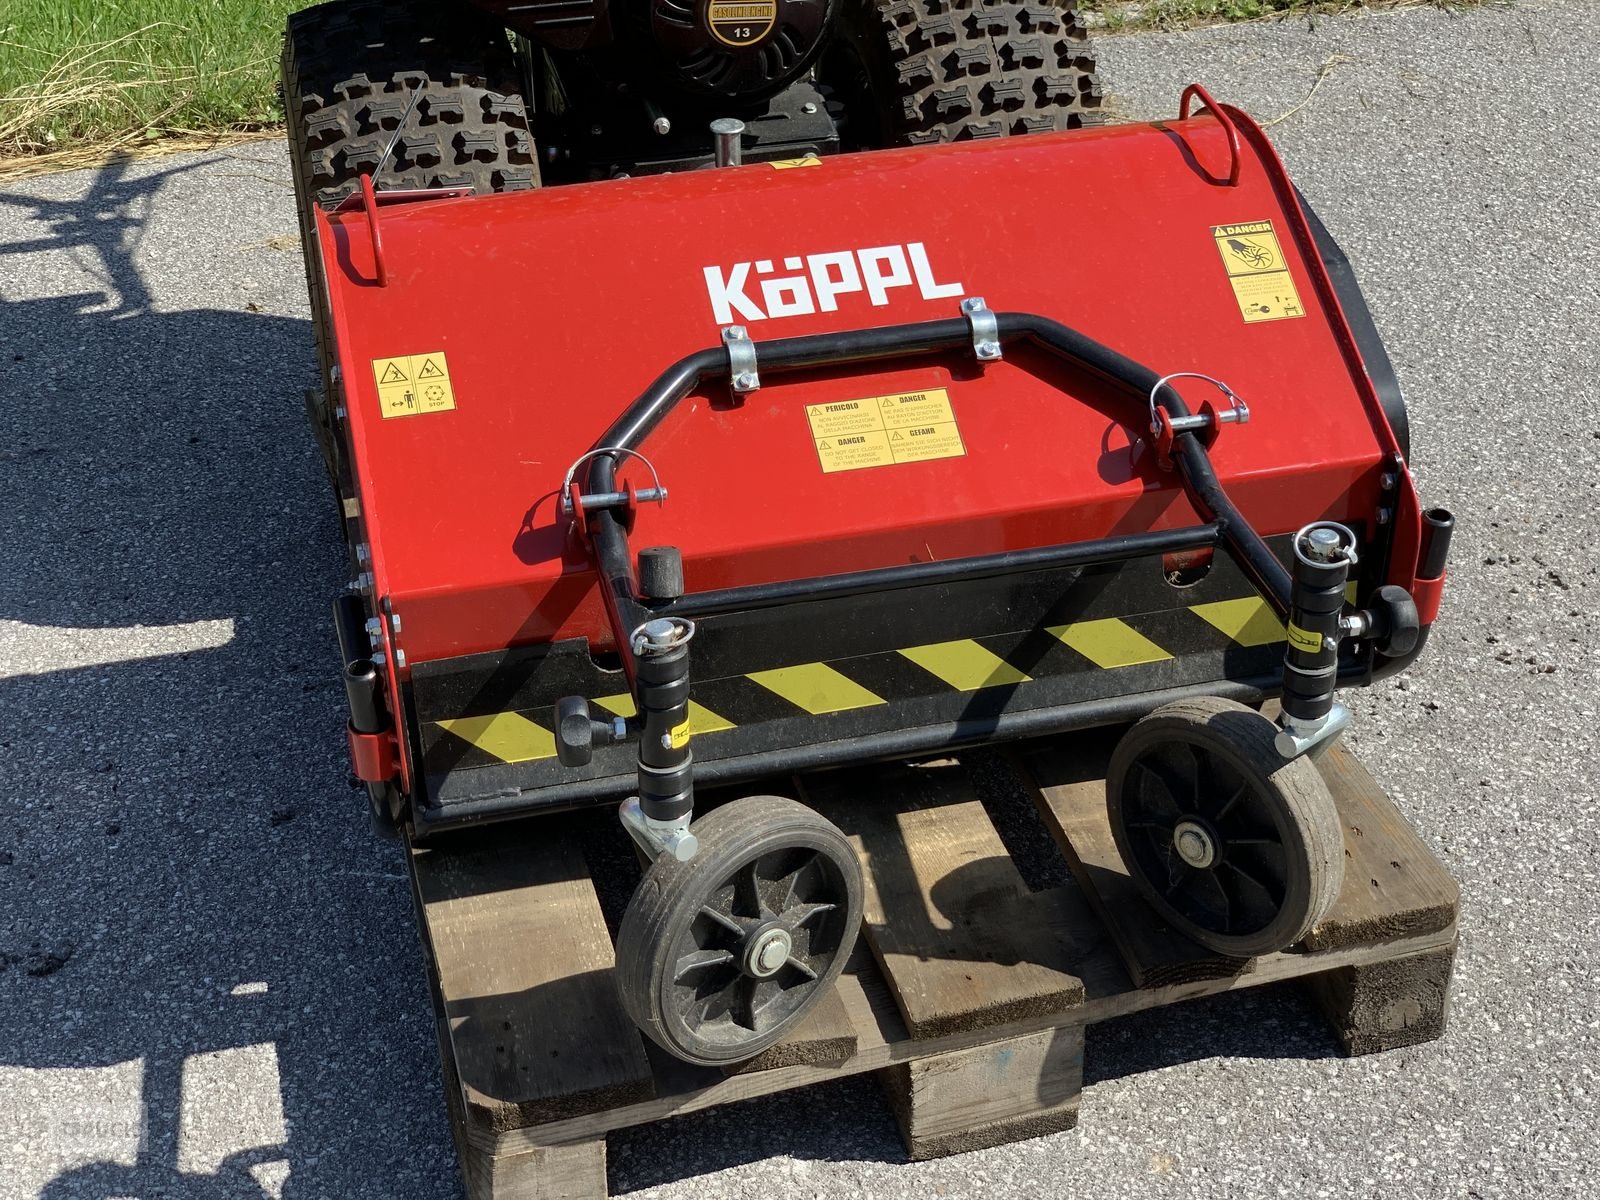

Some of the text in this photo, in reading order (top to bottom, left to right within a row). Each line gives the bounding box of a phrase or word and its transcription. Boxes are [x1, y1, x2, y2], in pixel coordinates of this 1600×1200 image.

[713, 6, 772, 18] GASOLINE ENGINE
[734, 27, 750, 38] 13
[1226, 223, 1271, 235] DANGER
[703, 242, 965, 325] KÖPPL
[899, 394, 927, 403] DANGER
[825, 402, 859, 413] PERICOLO
[909, 427, 936, 437] GEFAHR
[837, 436, 866, 446] DANGER
